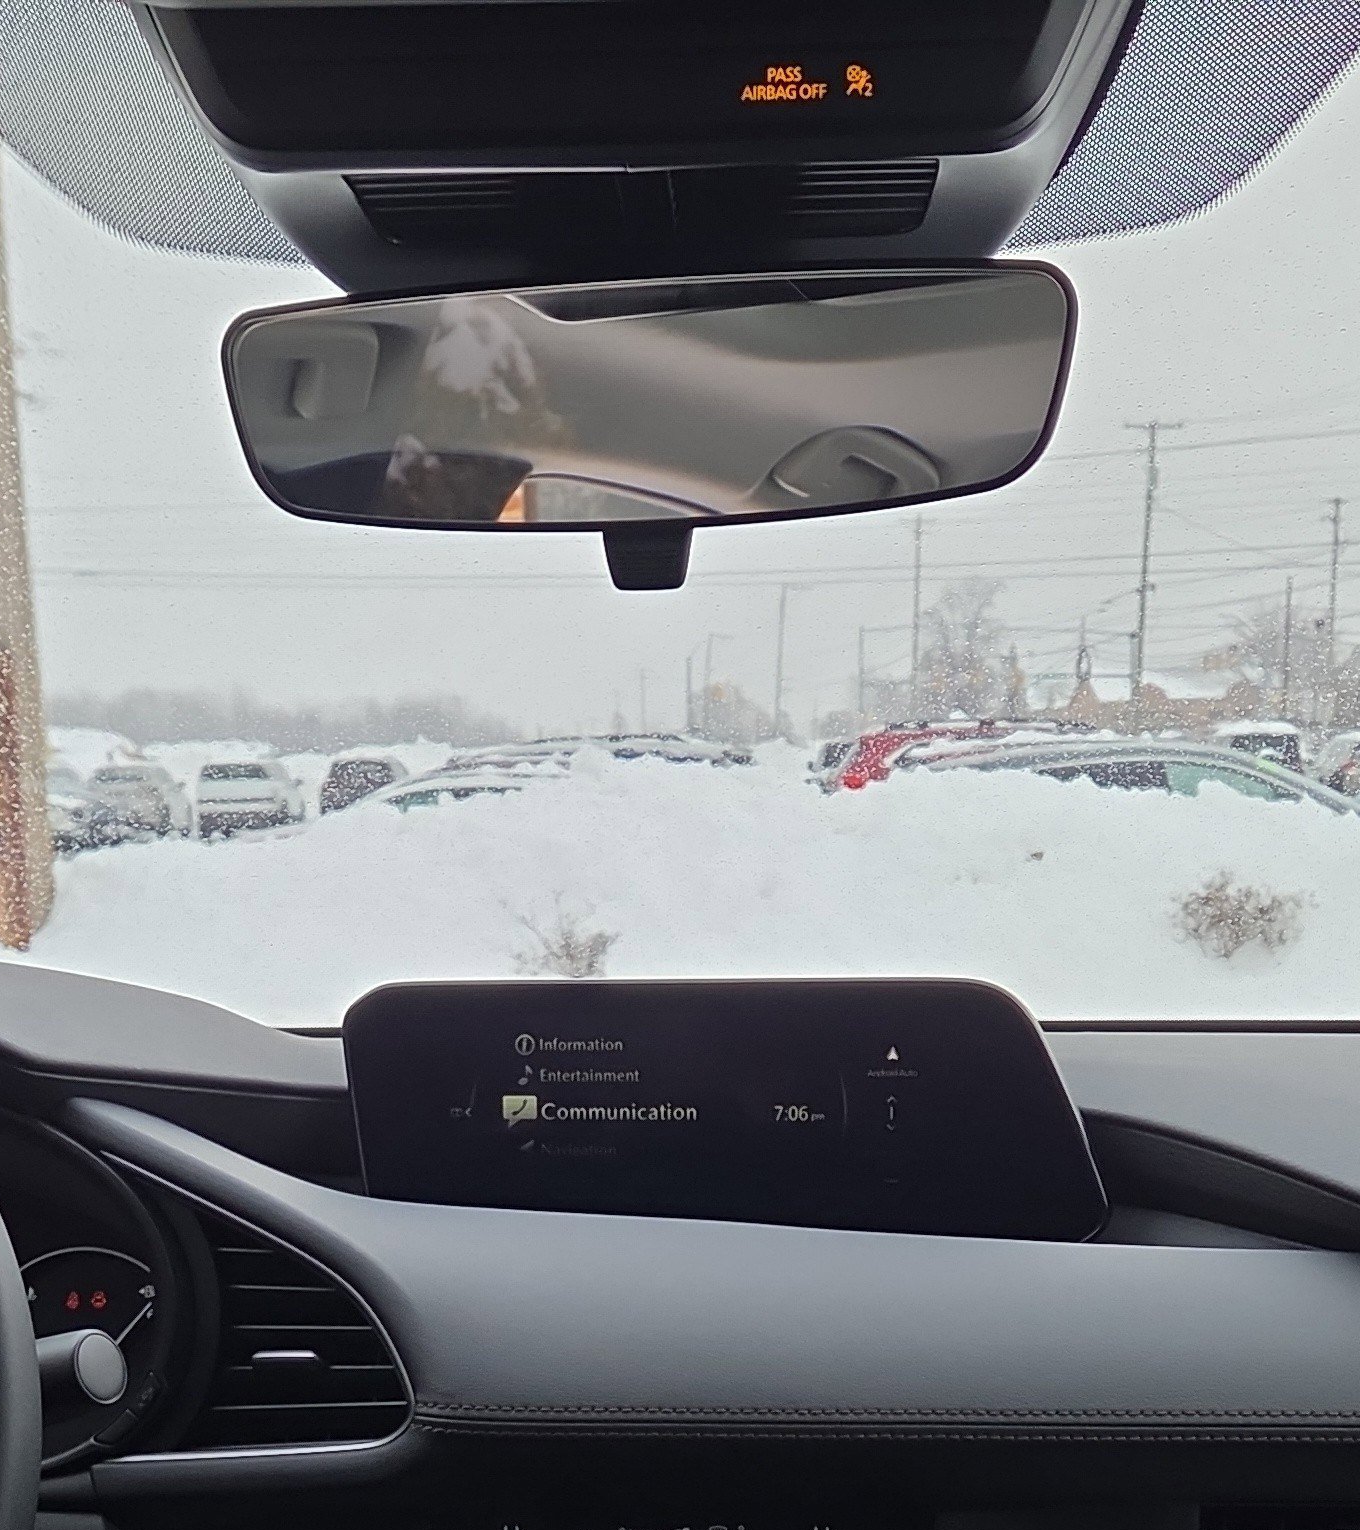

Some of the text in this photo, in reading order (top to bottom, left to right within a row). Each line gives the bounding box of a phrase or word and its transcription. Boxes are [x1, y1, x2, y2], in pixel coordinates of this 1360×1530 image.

[767, 66, 802, 82] PASS
[740, 83, 827, 100] AIRBAG OFF
[539, 1036, 624, 1052] Information
[539, 1067, 640, 1082] Entertainment
[540, 1102, 698, 1121] Communication
[774, 1105, 809, 1121] 7:06
